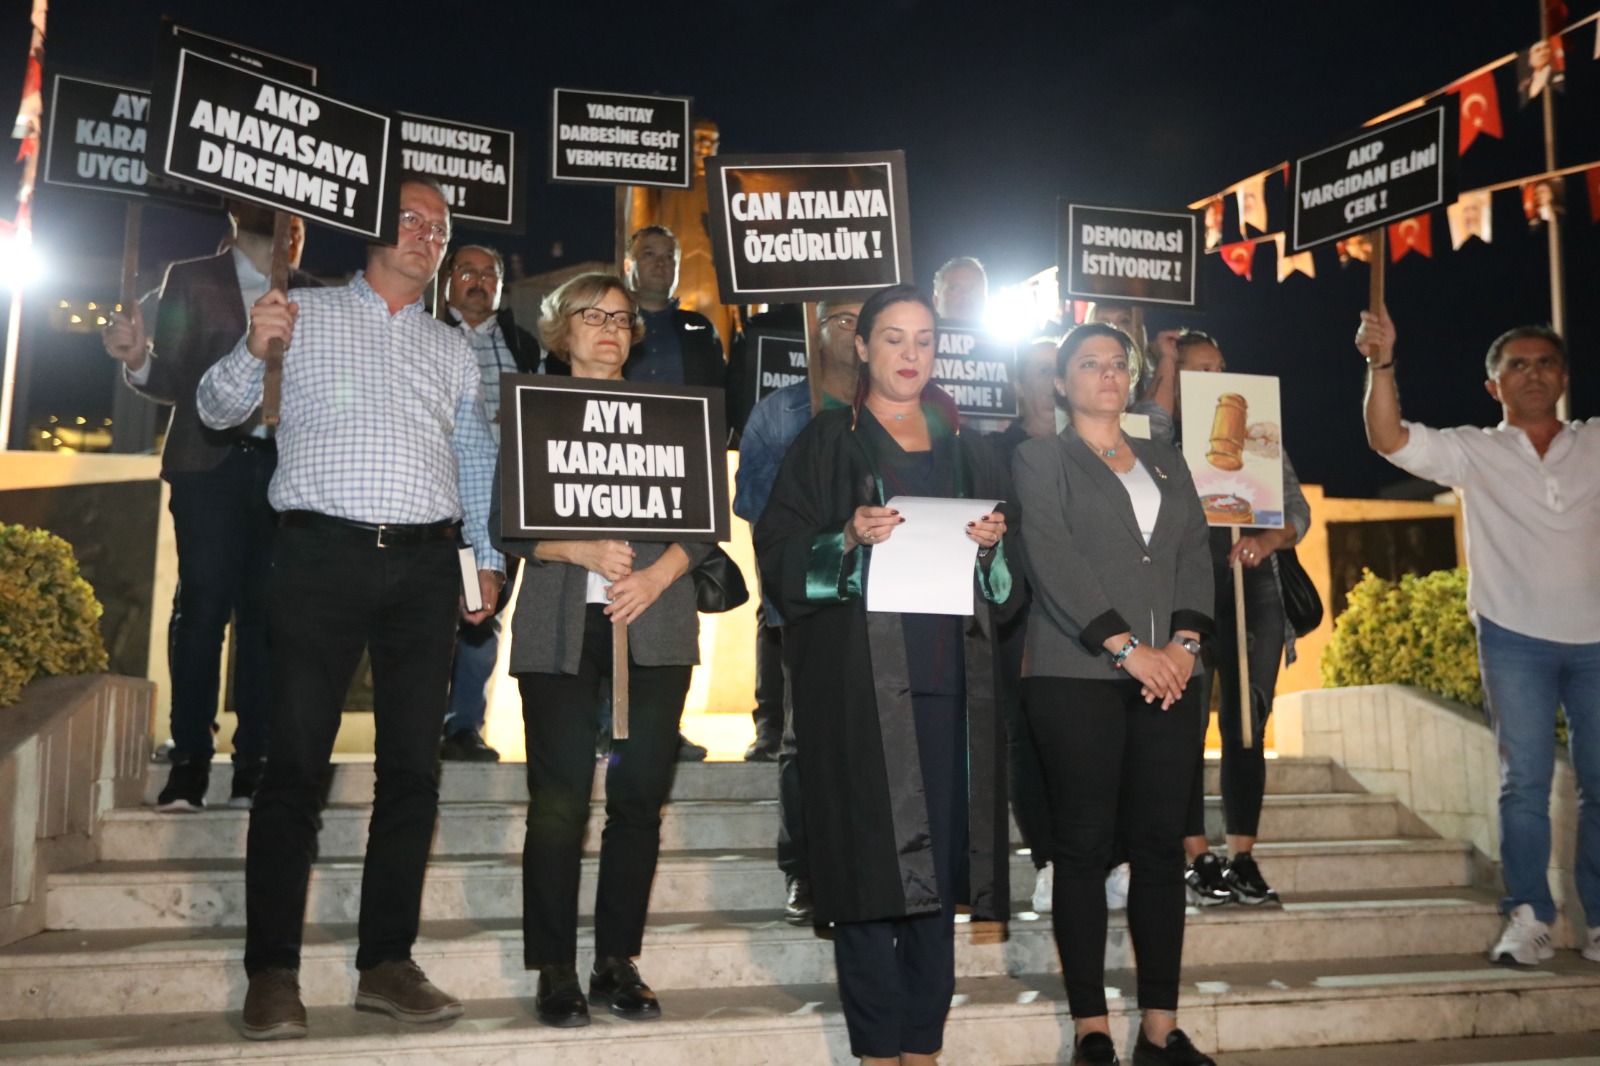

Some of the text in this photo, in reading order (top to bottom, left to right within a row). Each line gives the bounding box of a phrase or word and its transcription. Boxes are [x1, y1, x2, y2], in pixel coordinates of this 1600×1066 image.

[112, 93, 151, 122] AY
[254, 84, 321, 127] AKP
[586, 103, 655, 124] YARGITAY
[75, 118, 148, 153] KARA
[189, 99, 369, 185] ANAYASAYA
[560, 124, 680, 150] DARBESİNE GEÇİT
[77, 151, 149, 186] UYGU
[401, 149, 507, 185] TUKLULUĞA
[1346, 140, 1385, 170] AKP
[1301, 142, 1437, 210] YARGIDAN ELİNİ
[731, 189, 888, 221] CAN ATALAYA
[1082, 224, 1183, 253] DEMOKRASİ
[938, 333, 975, 355] AKP
[932, 358, 1009, 383] AYASAYA
[582, 399, 643, 435] AYM
[547, 439, 686, 478] KARARINI
